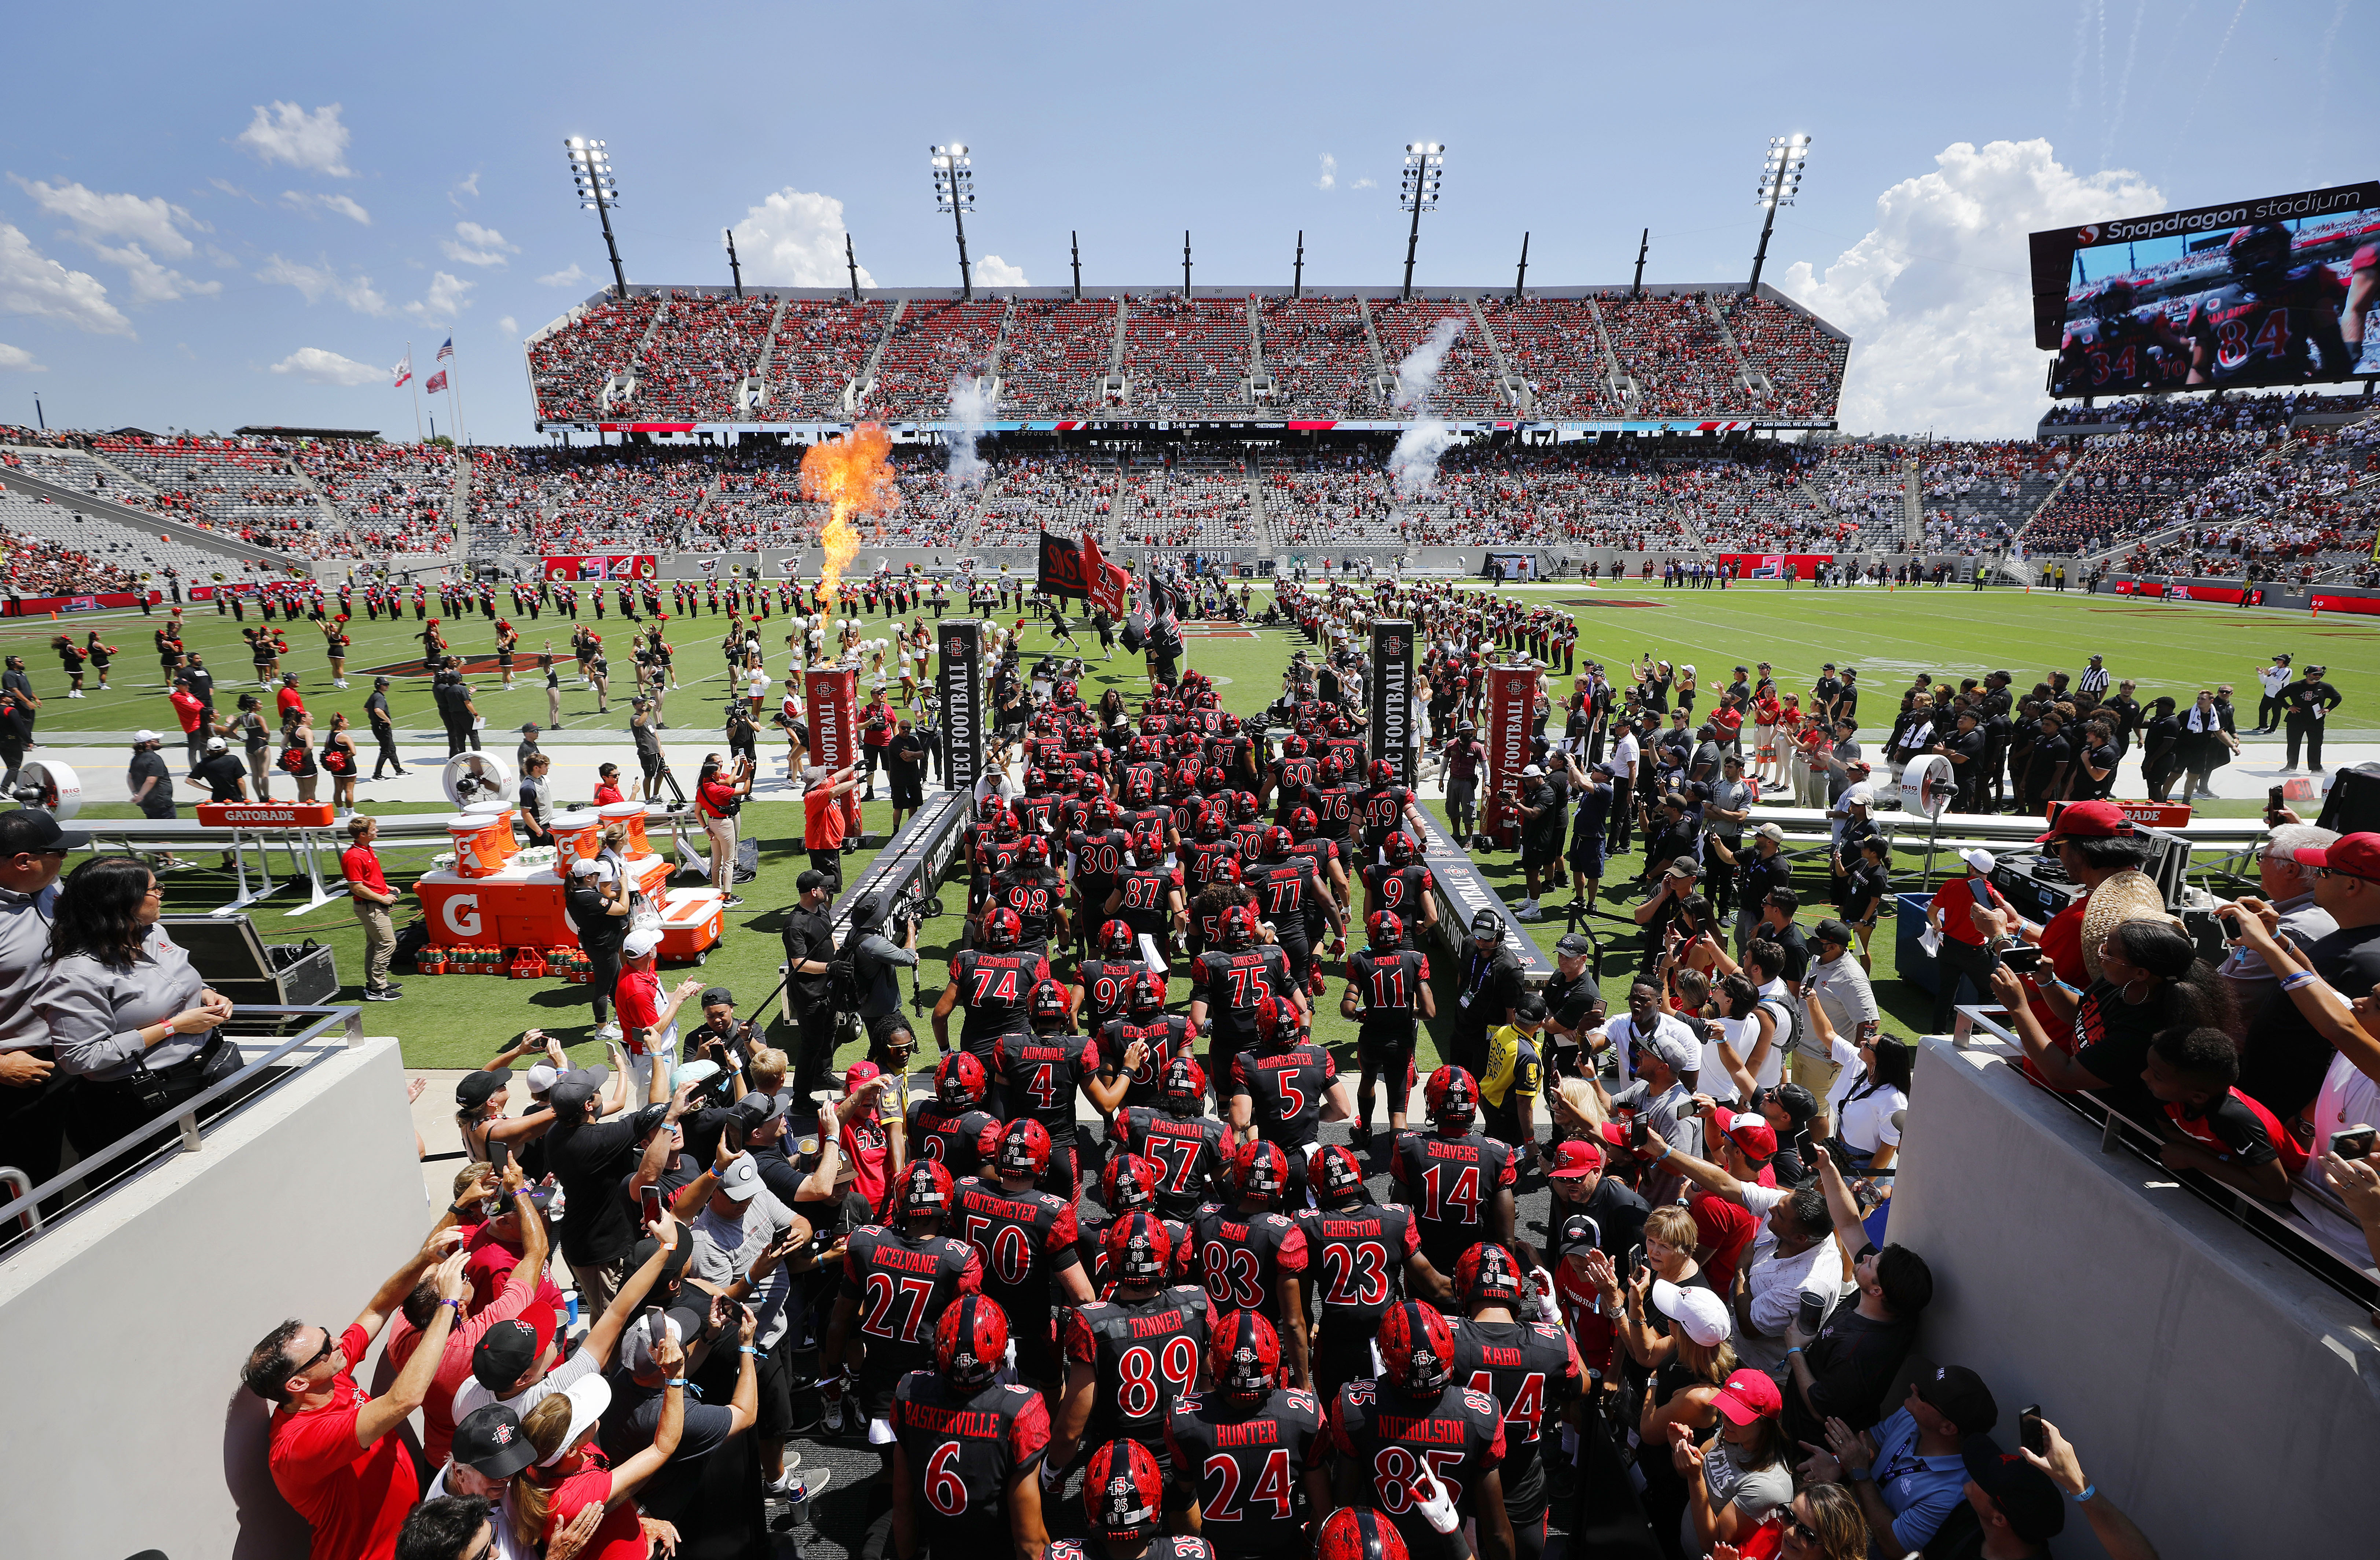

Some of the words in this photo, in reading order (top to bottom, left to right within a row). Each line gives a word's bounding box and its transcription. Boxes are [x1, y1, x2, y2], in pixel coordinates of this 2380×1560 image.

[2107, 206, 2247, 239] Snapdragon
[2254, 191, 2360, 219] stadium
[2216, 308, 2291, 371] 84
[920, 422, 934, 431] SAN
[936, 422, 961, 431] DIEGO
[1558, 422, 1572, 431] SAN
[1573, 422, 1598, 431] DIEGO
[1599, 422, 1623, 431] STATE
[1197, 551, 1231, 564] FIELD
[949, 662, 969, 748] FOOTBALL
[1385, 661, 1405, 747] FOOTBALL
[819, 701, 839, 770] FOOTBALL
[1505, 699, 1523, 768] FOOTBALL
[1212, 745, 1235, 766] 97
[1330, 747, 1355, 768] 63
[1126, 768, 1153, 787] 70
[1283, 765, 1312, 787] 60
[2295, 780, 2314, 799] 30
[225, 810, 295, 821] GATORADE
[1136, 810, 1157, 819] CHAVEZ
[1321, 795, 1349, 820] 76
[1366, 799, 1397, 827] 49
[1026, 805, 1050, 832] 17
[1133, 818, 1163, 839] 64
[1086, 836, 1107, 844] OLIVER
[1231, 832, 1261, 860] 20
[1081, 845, 1118, 874] 30
[1270, 868, 1298, 879] SIMMONS
[1009, 886, 1048, 916] 98
[1125, 878, 1161, 909] 87
[1268, 879, 1302, 913] 77
[1383, 878, 1403, 909] 9
[977, 956, 1020, 968] AZZOPARDI
[1103, 965, 1130, 975] REESER
[1232, 954, 1263, 967] DIRKSEN
[1374, 955, 1400, 966] PENNY
[972, 969, 1018, 1008] 74
[1228, 965, 1270, 1008] 75
[1370, 968, 1407, 1008] 11
[1122, 1022, 1169, 1038] CELESTINE
[1021, 1046, 1065, 1061] AUMAVAE
[1491, 1038, 1506, 1061] CSC
[1257, 1053, 1313, 1068] BURMEISTER
[1174, 1071, 1182, 1079] 57
[1026, 1063, 1056, 1109] 4
[1277, 1068, 1305, 1120] 5
[1453, 1094, 1462, 1103] 14
[917, 1112, 962, 1133] BARFIELD
[1150, 1118, 1203, 1138] MASANIAI
[1008, 1147, 1019, 1156] 50
[1428, 1141, 1479, 1162] SHAVERS
[1144, 1134, 1202, 1193] 57
[1332, 1166, 1342, 1177] 23
[1255, 1171, 1265, 1180] 83
[916, 1182, 926, 1192] 27
[1122, 1187, 1132, 1196] 22
[1333, 1186, 1354, 1197] AZTECS
[1422, 1163, 1484, 1224] 14
[909, 1207, 932, 1217] AZTECS
[962, 1190, 1038, 1222] WINTERMEYER
[1219, 1221, 1249, 1241] SHAW
[1323, 1219, 1381, 1237] CHRISTON
[872, 1244, 939, 1274] MCELVANE
[965, 1214, 1031, 1285] 50
[1132, 1252, 1144, 1262] 89
[1202, 1240, 1265, 1309] 83
[1323, 1241, 1388, 1306] 23
[1487, 1262, 1500, 1272] 44
[1483, 1289, 1509, 1299] AZTECS
[861, 1272, 935, 1344] 27
[1129, 1309, 1183, 1339] TANNER
[1481, 1345, 1521, 1367] KAHO
[1118, 1335, 1199, 1418] 89
[1238, 1365, 1250, 1377] 24
[1418, 1368, 1432, 1379] 85
[1466, 1370, 1547, 1444] 44
[904, 1400, 1000, 1439] BASKERVILLE
[1378, 1414, 1465, 1445] NICHOLSON
[1216, 1419, 1278, 1447] HUNTER
[925, 1441, 967, 1516] 6
[1202, 1448, 1296, 1521] 24
[1374, 1446, 1465, 1514] 85
[1114, 1498, 1128, 1512] 35
[1106, 1530, 1139, 1541] AZTECS
